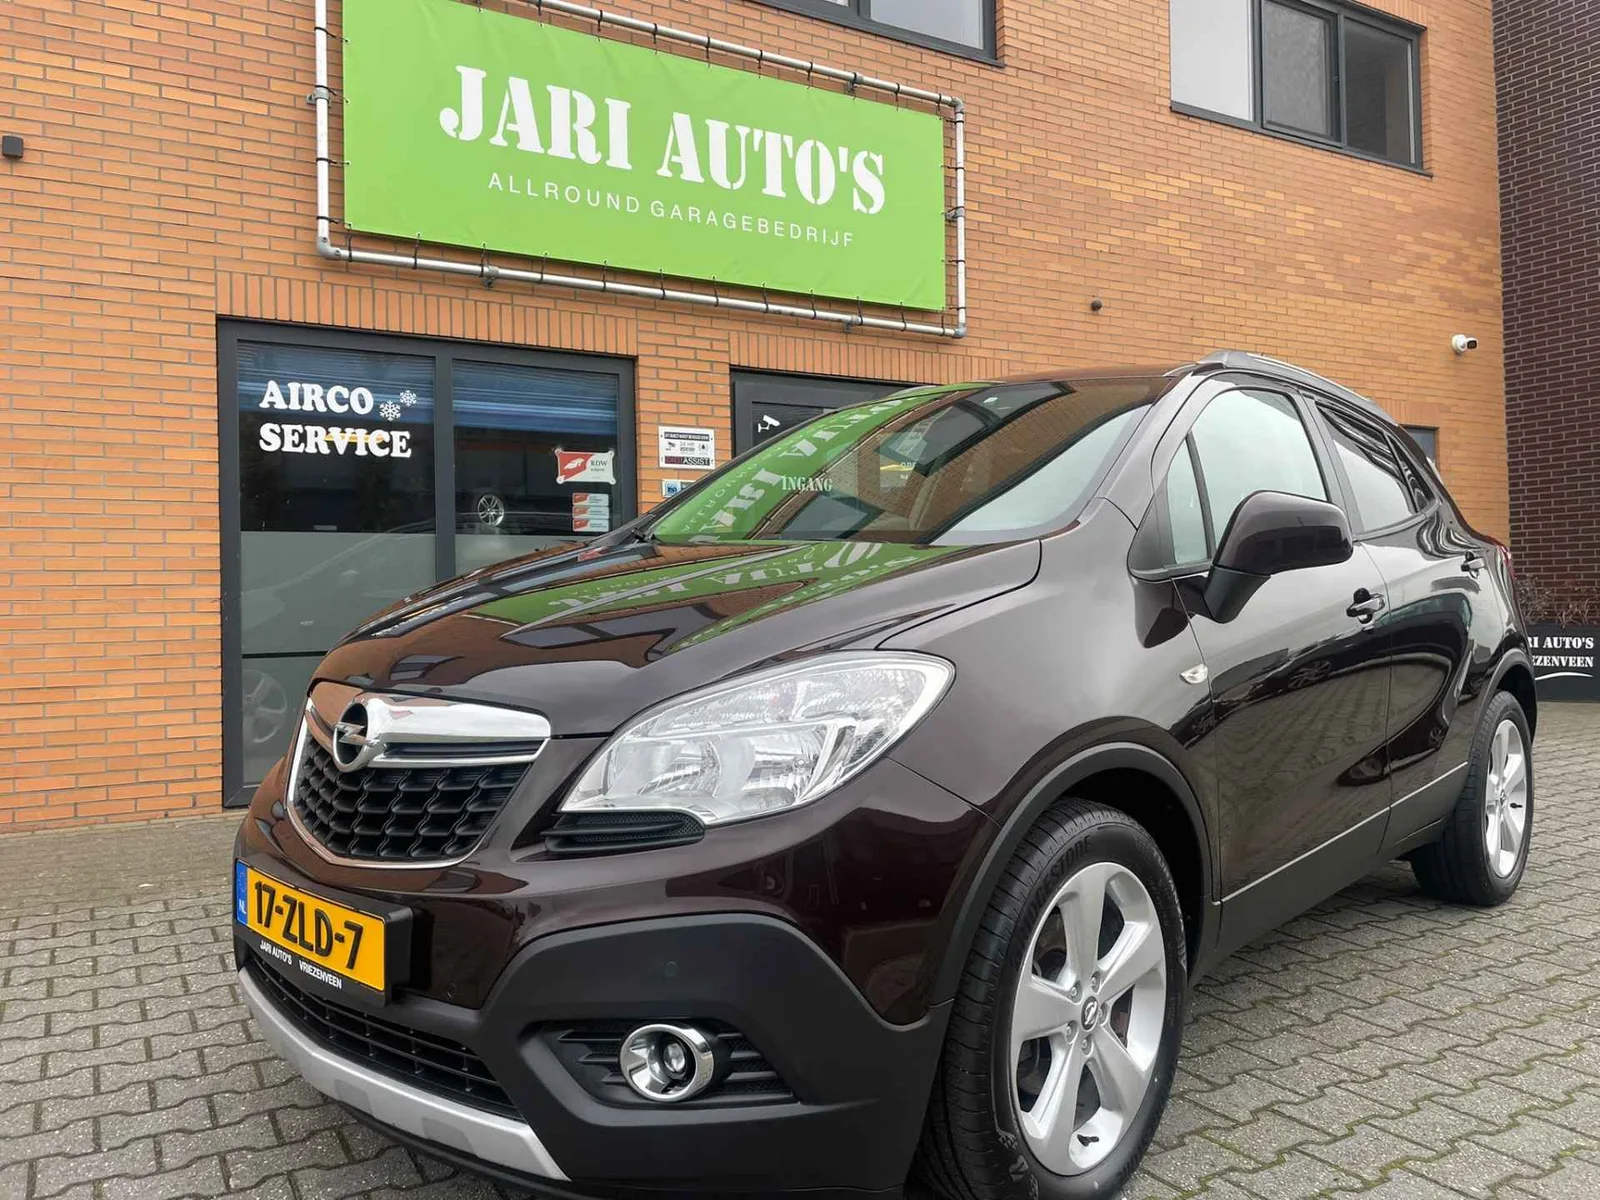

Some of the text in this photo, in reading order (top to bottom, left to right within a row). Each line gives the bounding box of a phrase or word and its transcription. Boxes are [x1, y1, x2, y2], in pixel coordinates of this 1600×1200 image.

[438, 65, 886, 215] JARI AUTO'S
[488, 172, 855, 248] ALLROUND GARAGEBEDRIJF
[259, 380, 374, 415] AIRCO
[259, 423, 412, 458] SERVICE
[782, 476, 833, 492] INGANG
[1543, 636, 1594, 649] AUTO'S
[238, 899, 247, 914] NL
[254, 880, 363, 970] 17-ZLD-7
[260, 940, 342, 989] JARI AUTO'S VRIEZENVEEN
